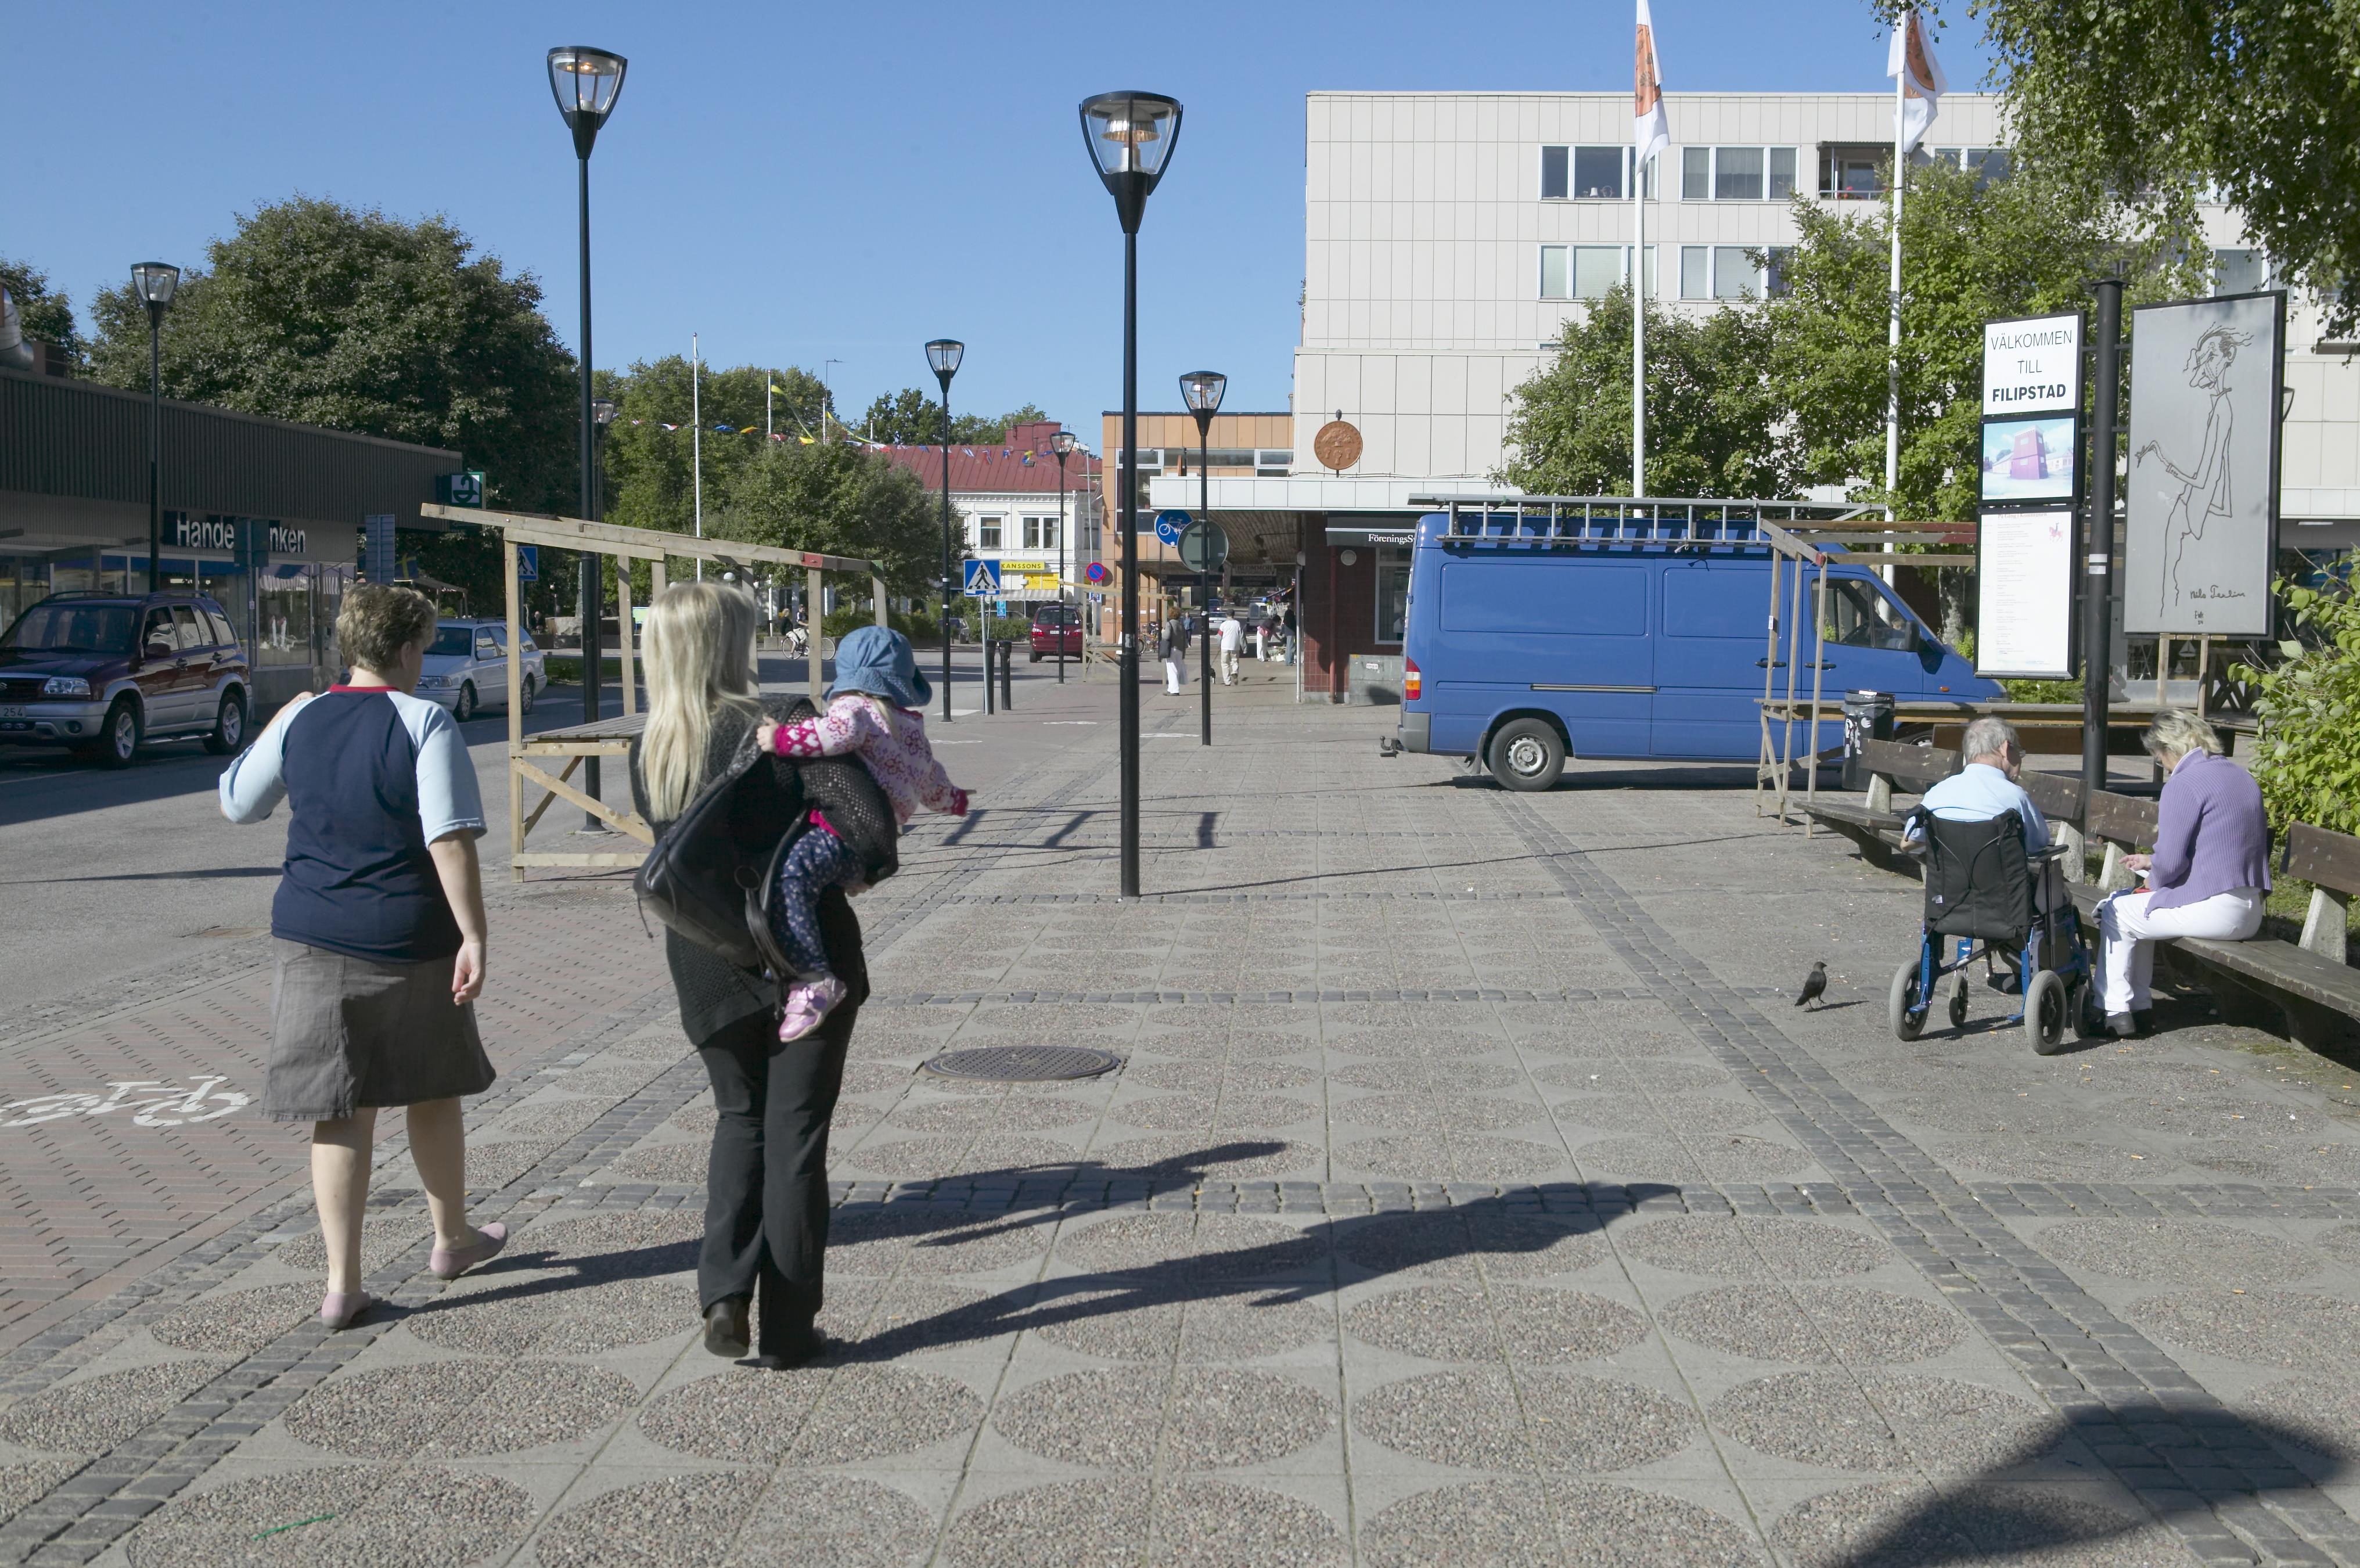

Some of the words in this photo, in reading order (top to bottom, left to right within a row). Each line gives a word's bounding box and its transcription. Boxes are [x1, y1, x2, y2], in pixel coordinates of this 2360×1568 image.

[1991, 330, 2072, 350] VÄLKOMMEN
[2017, 359, 2042, 374] TILL
[1992, 384, 2066, 402] FILIPSTAD
[1368, 534, 1415, 545] FöreningsS
[3, 707, 23, 717] 254
